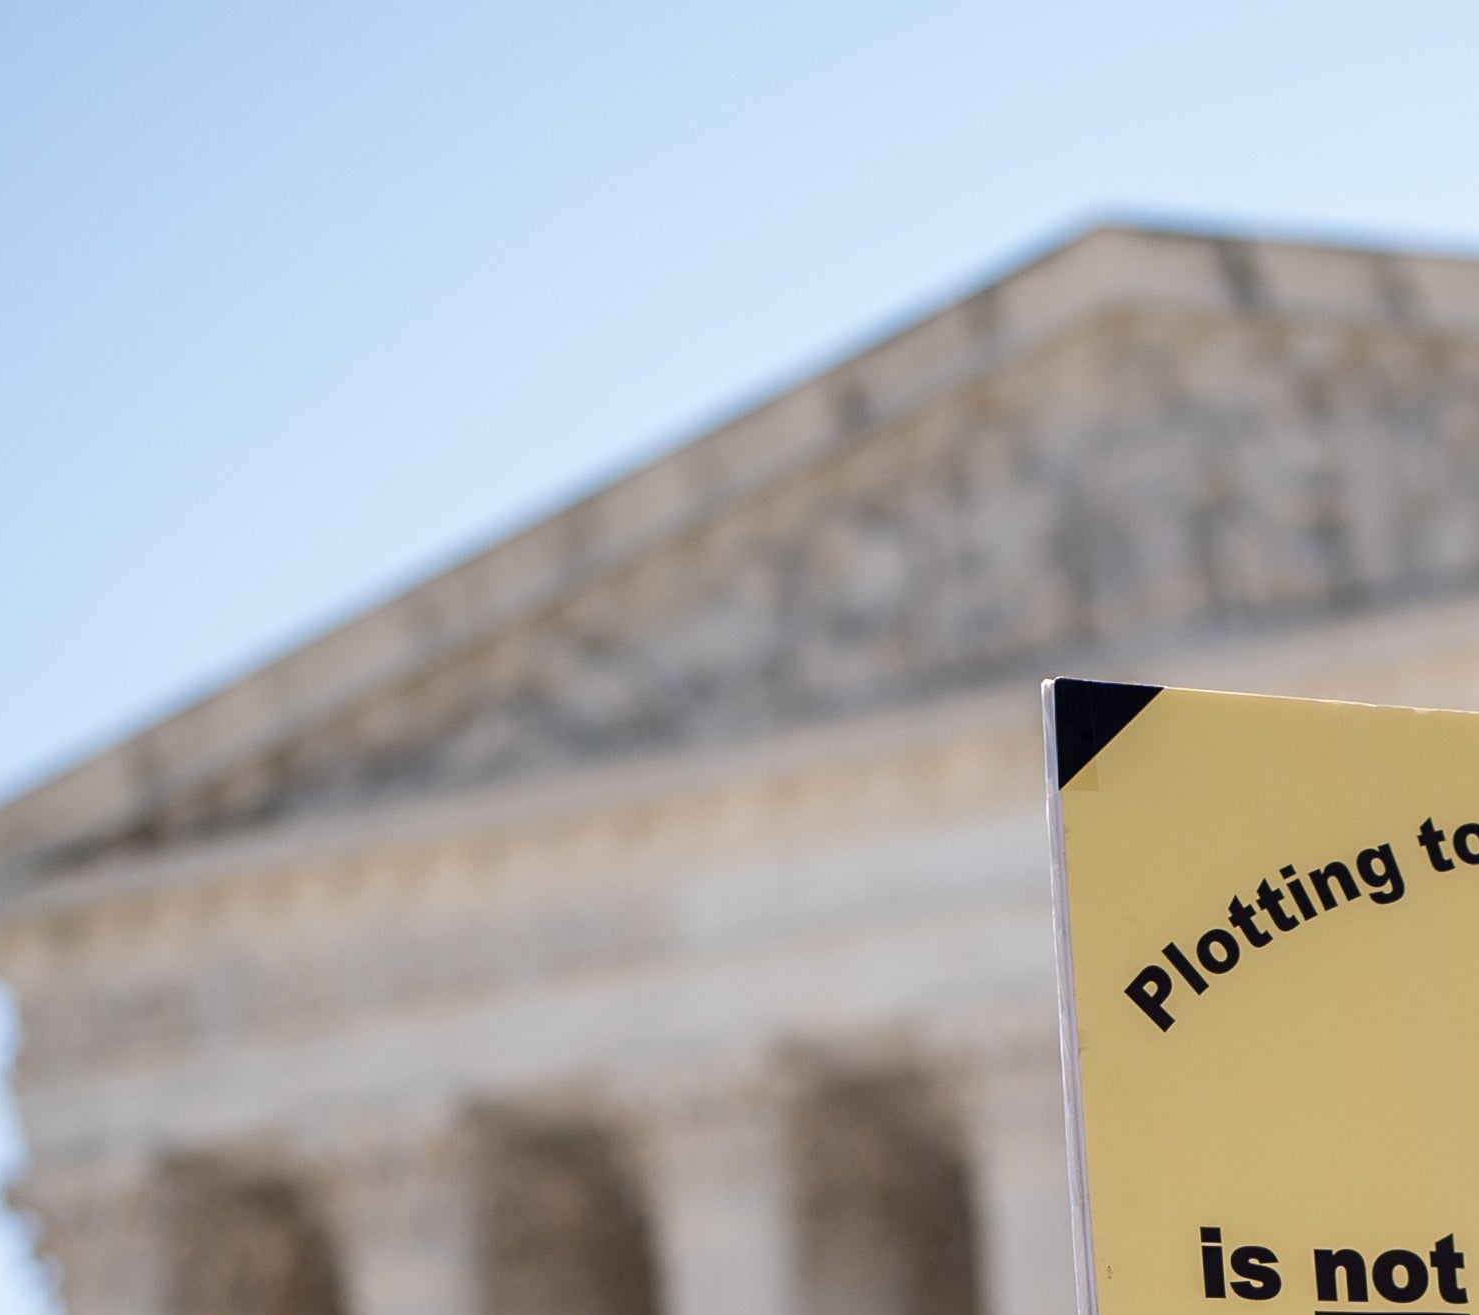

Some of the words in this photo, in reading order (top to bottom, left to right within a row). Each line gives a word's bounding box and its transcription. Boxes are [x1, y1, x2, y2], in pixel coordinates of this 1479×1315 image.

[1123, 842, 1406, 1033] Plotting
[1199, 1226, 1282, 1301] is
[1313, 1233, 1470, 1305] not
